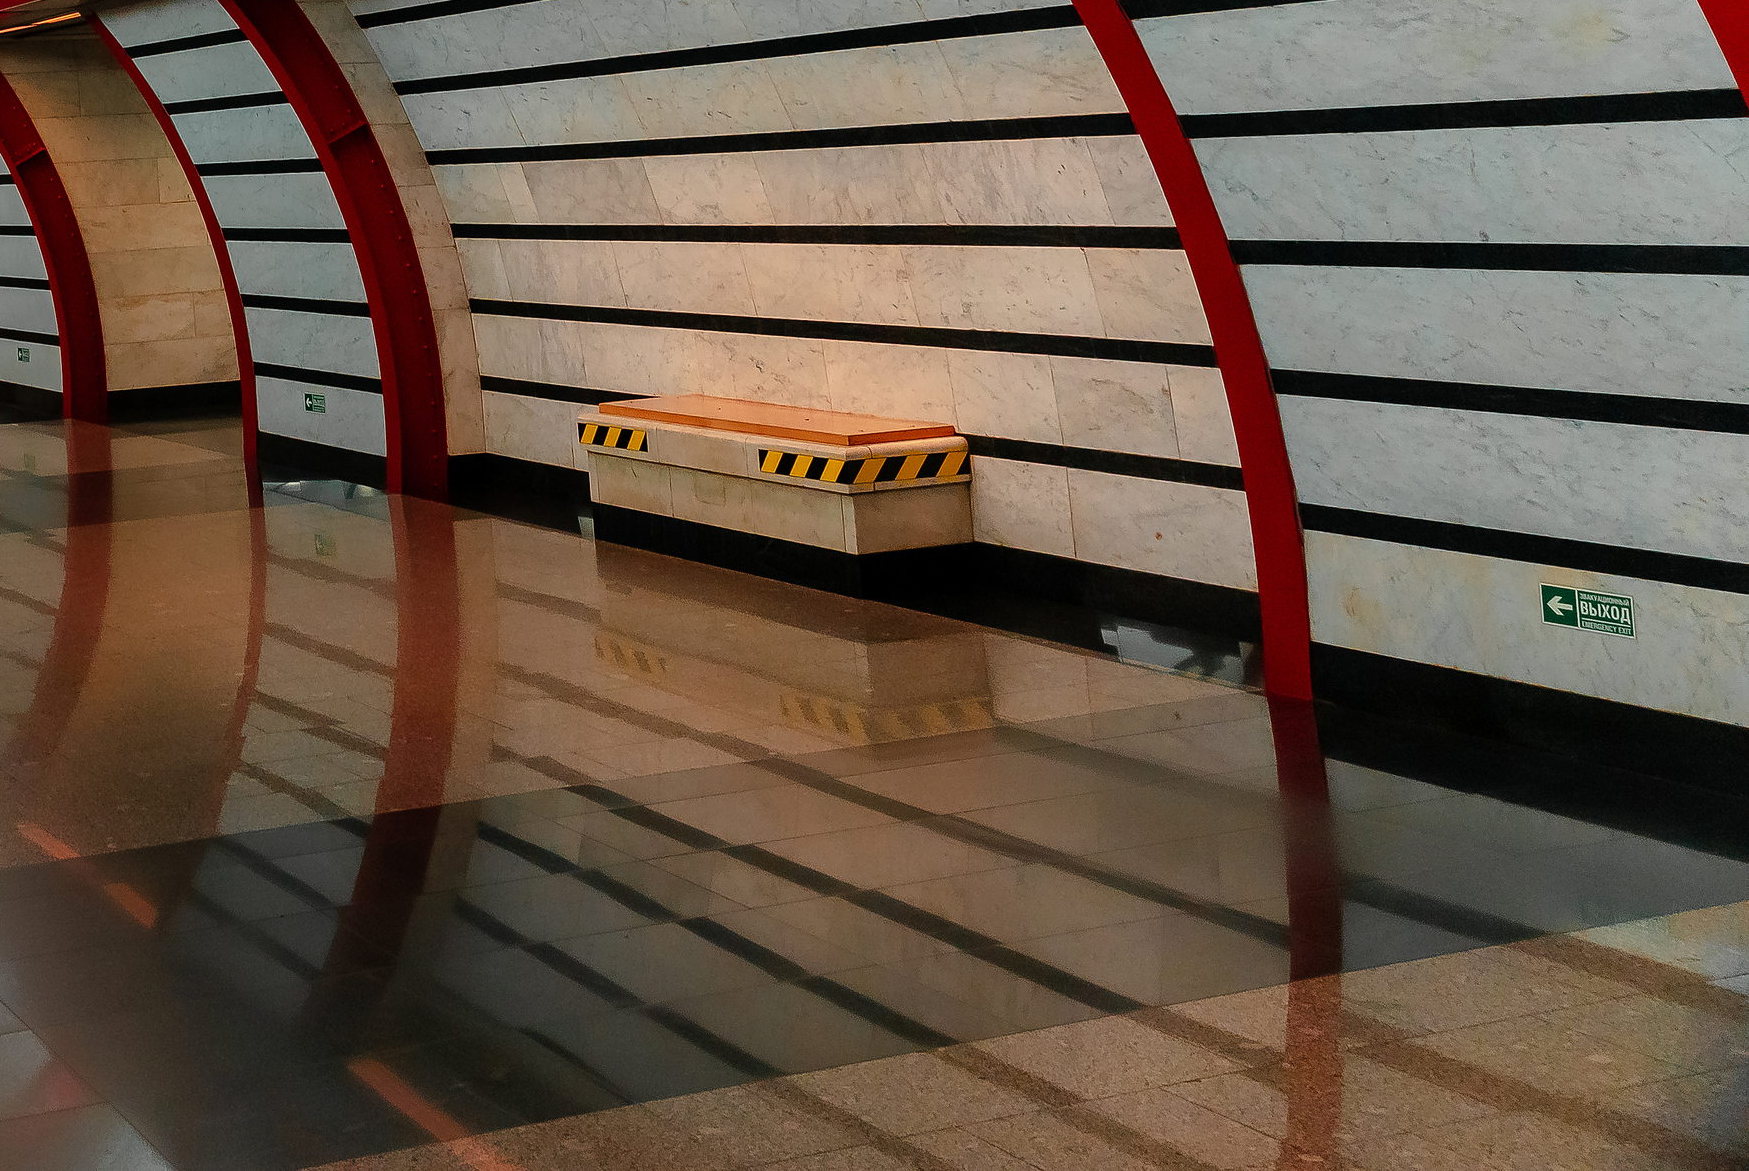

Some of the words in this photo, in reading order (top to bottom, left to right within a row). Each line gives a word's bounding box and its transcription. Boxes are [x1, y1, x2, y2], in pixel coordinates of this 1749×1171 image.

[1580, 601, 1631, 624] ВЫХОД
[1582, 621, 1617, 632] EMERGENCY
[1618, 627, 1632, 635] EXIT
